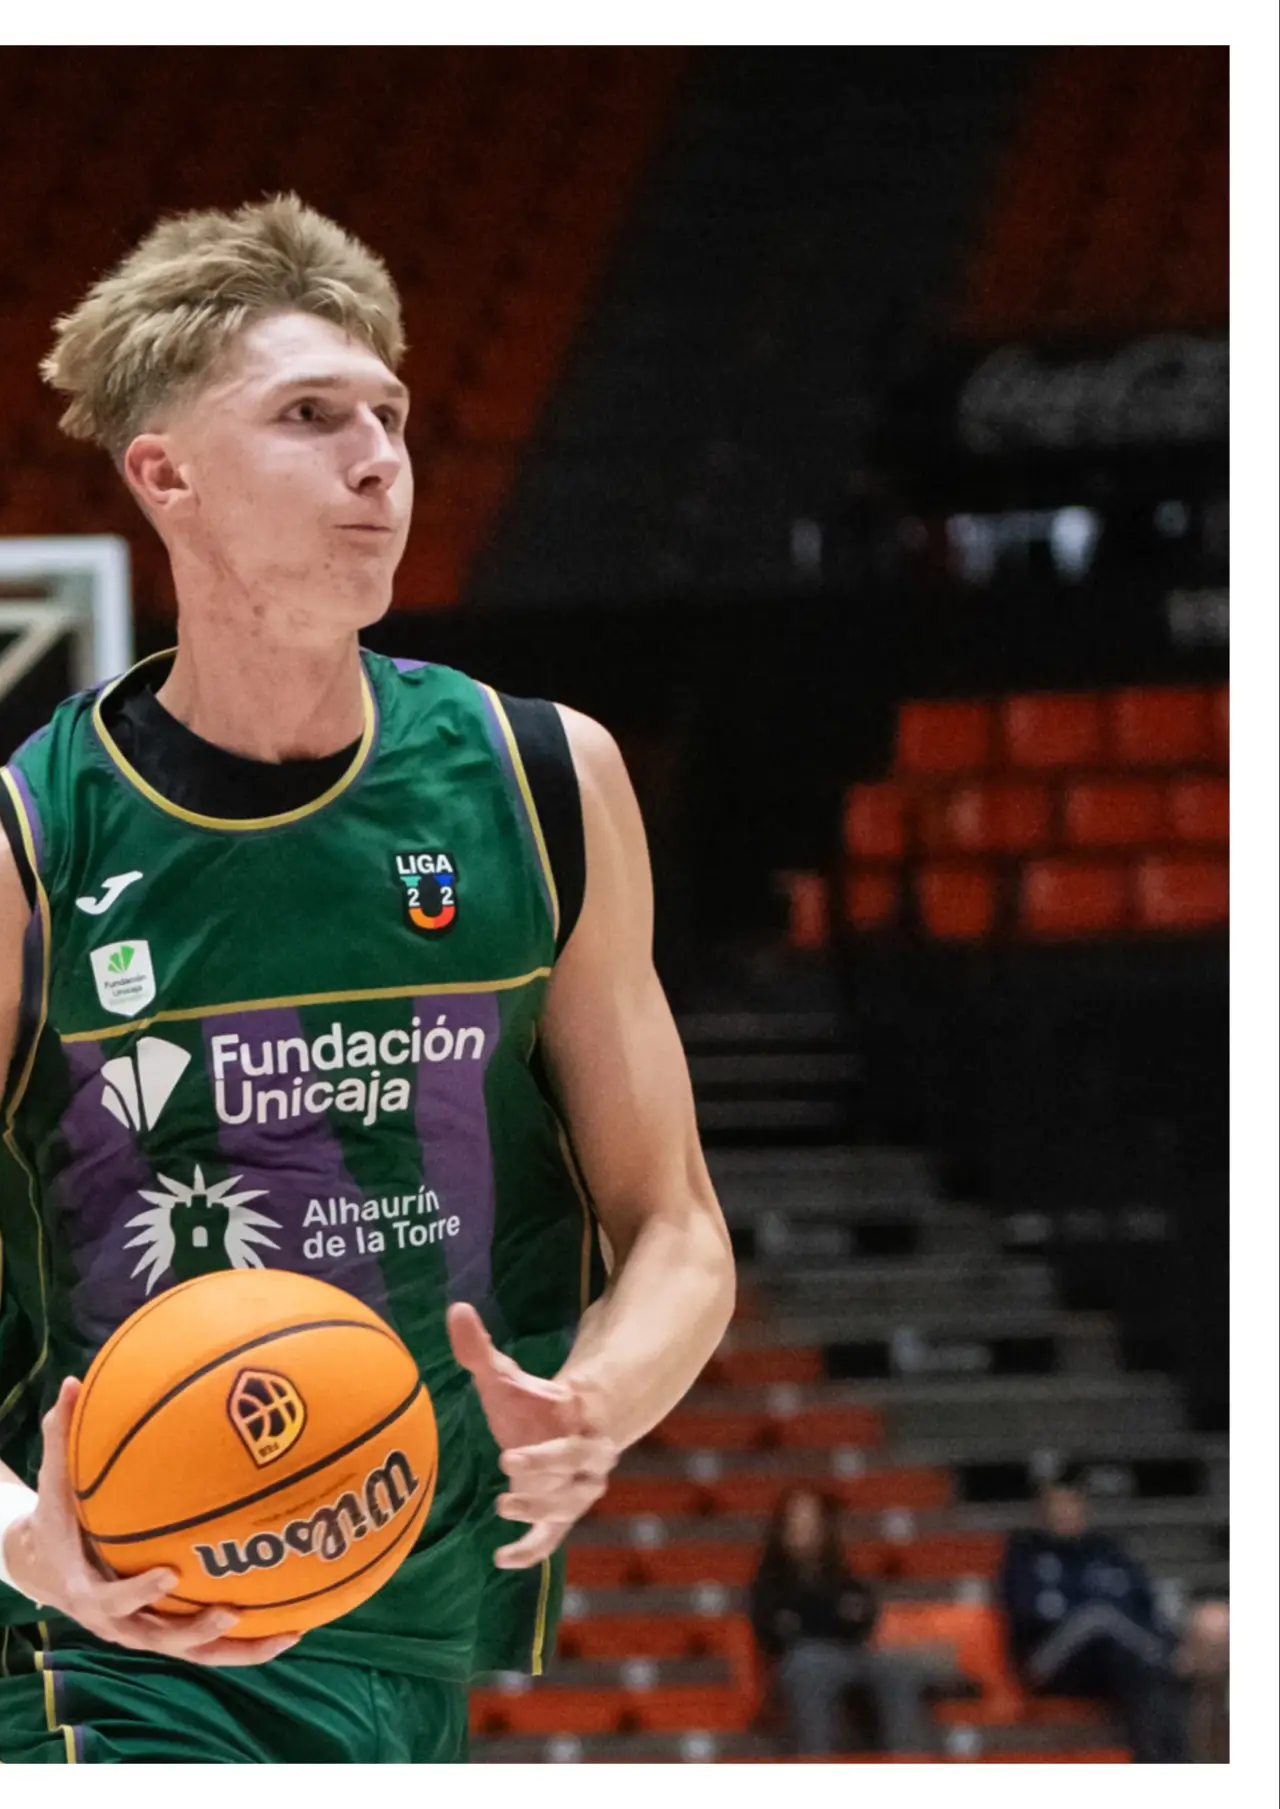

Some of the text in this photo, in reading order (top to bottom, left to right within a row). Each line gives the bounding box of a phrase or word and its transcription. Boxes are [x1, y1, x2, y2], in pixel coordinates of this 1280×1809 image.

[395, 853, 454, 875] LIGA
[211, 1014, 486, 1080] Fundación
[214, 1069, 412, 1127] Unicaja
[301, 1184, 440, 1228] Alhaurín
[302, 1214, 461, 1260] de la Torre
[193, 1448, 420, 1579] Wilson
